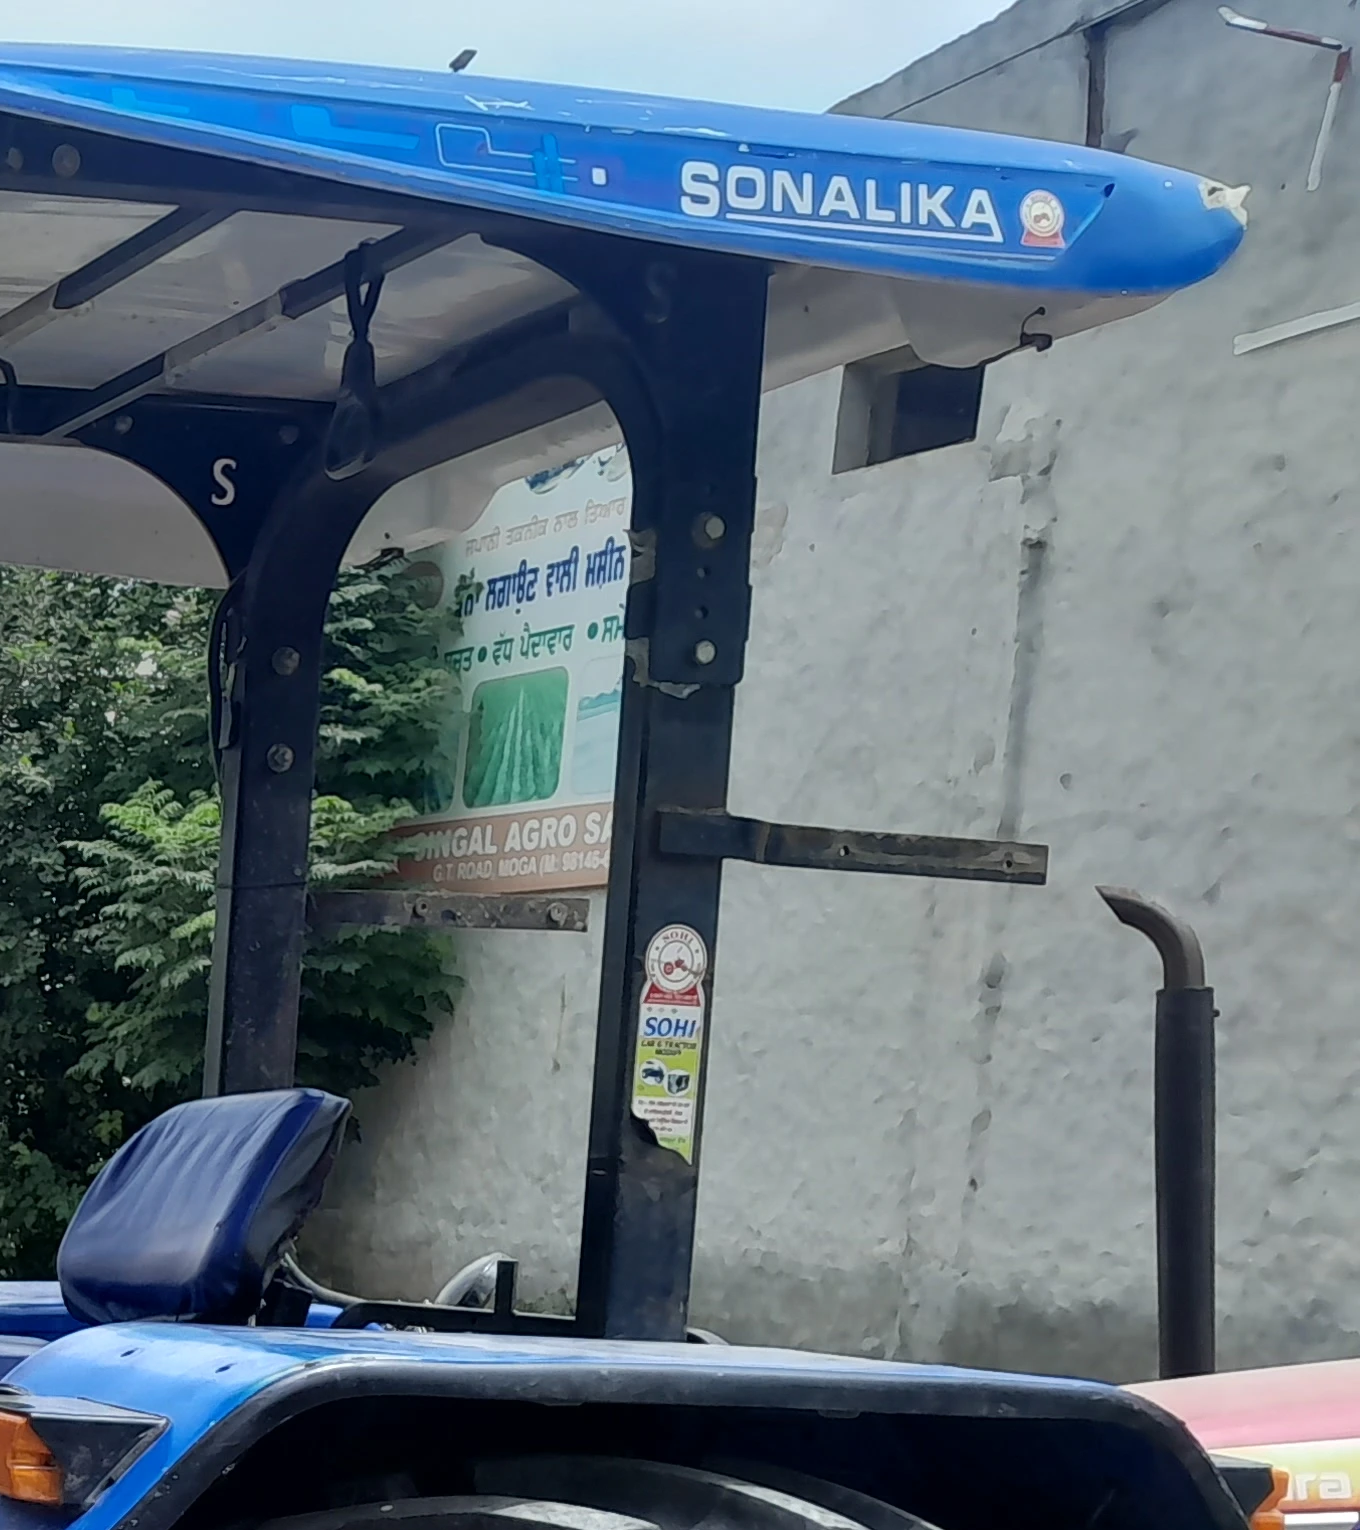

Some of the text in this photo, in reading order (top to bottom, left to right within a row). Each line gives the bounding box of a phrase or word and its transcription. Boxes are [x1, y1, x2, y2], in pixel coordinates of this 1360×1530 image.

[680, 160, 1004, 243] SONALIKA
[211, 458, 237, 506] S
[546, 545, 580, 597] ਵਾਲੀ
[504, 813, 576, 852] AGRO
[499, 855, 537, 877] MOGA
[643, 1016, 696, 1038] SOHI
